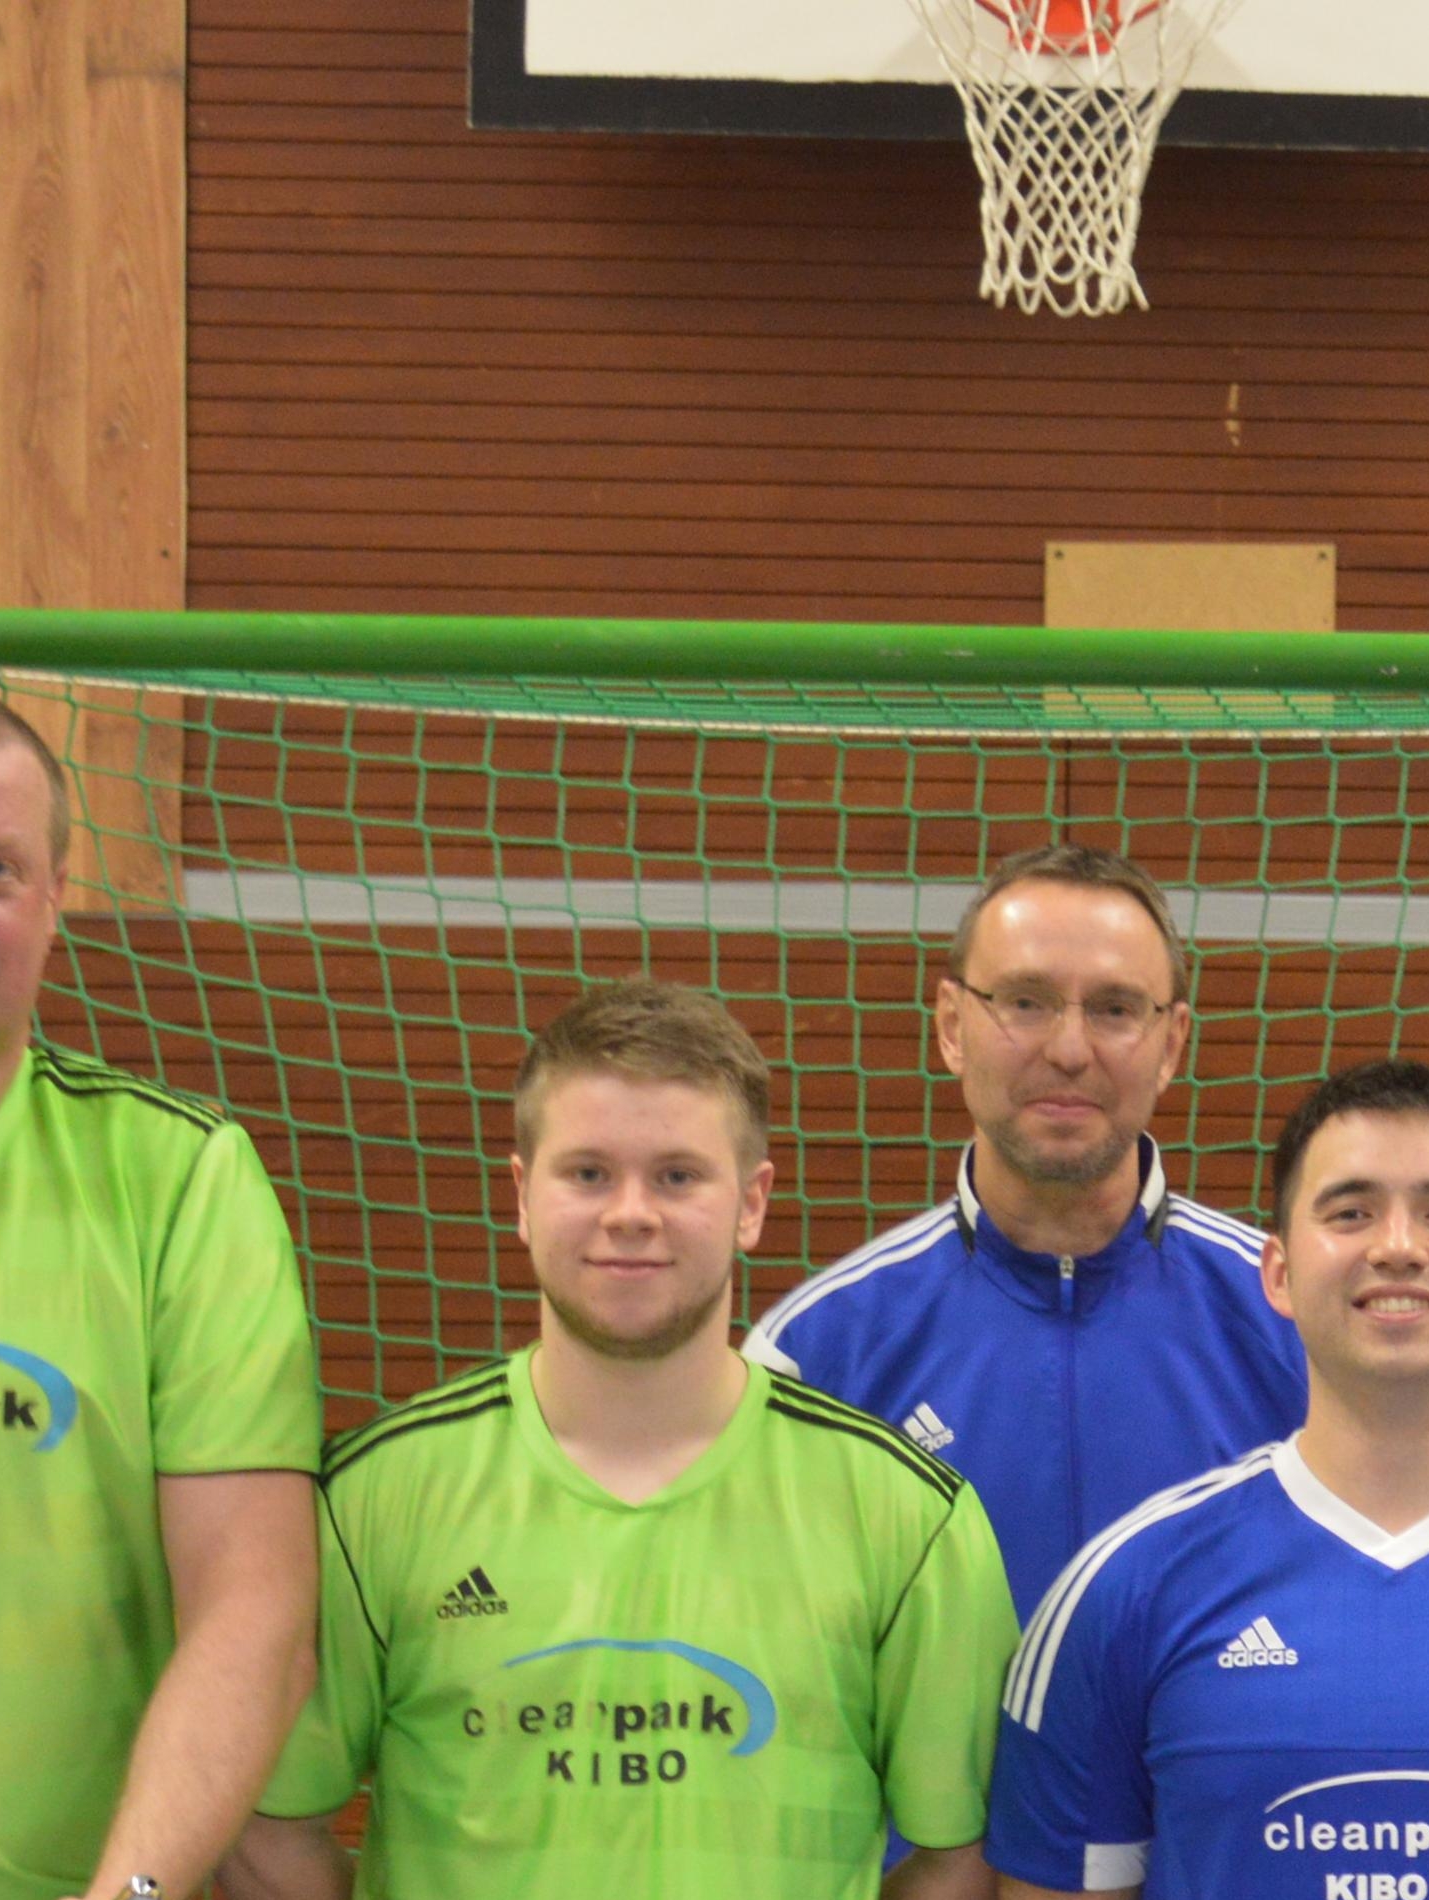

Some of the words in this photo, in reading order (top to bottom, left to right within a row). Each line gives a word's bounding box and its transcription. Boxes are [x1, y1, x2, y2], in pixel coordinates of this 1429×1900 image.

[436, 1599, 509, 1620] adidas
[1217, 1645, 1299, 1669] adidas
[546, 1748, 689, 1786] KIBO
